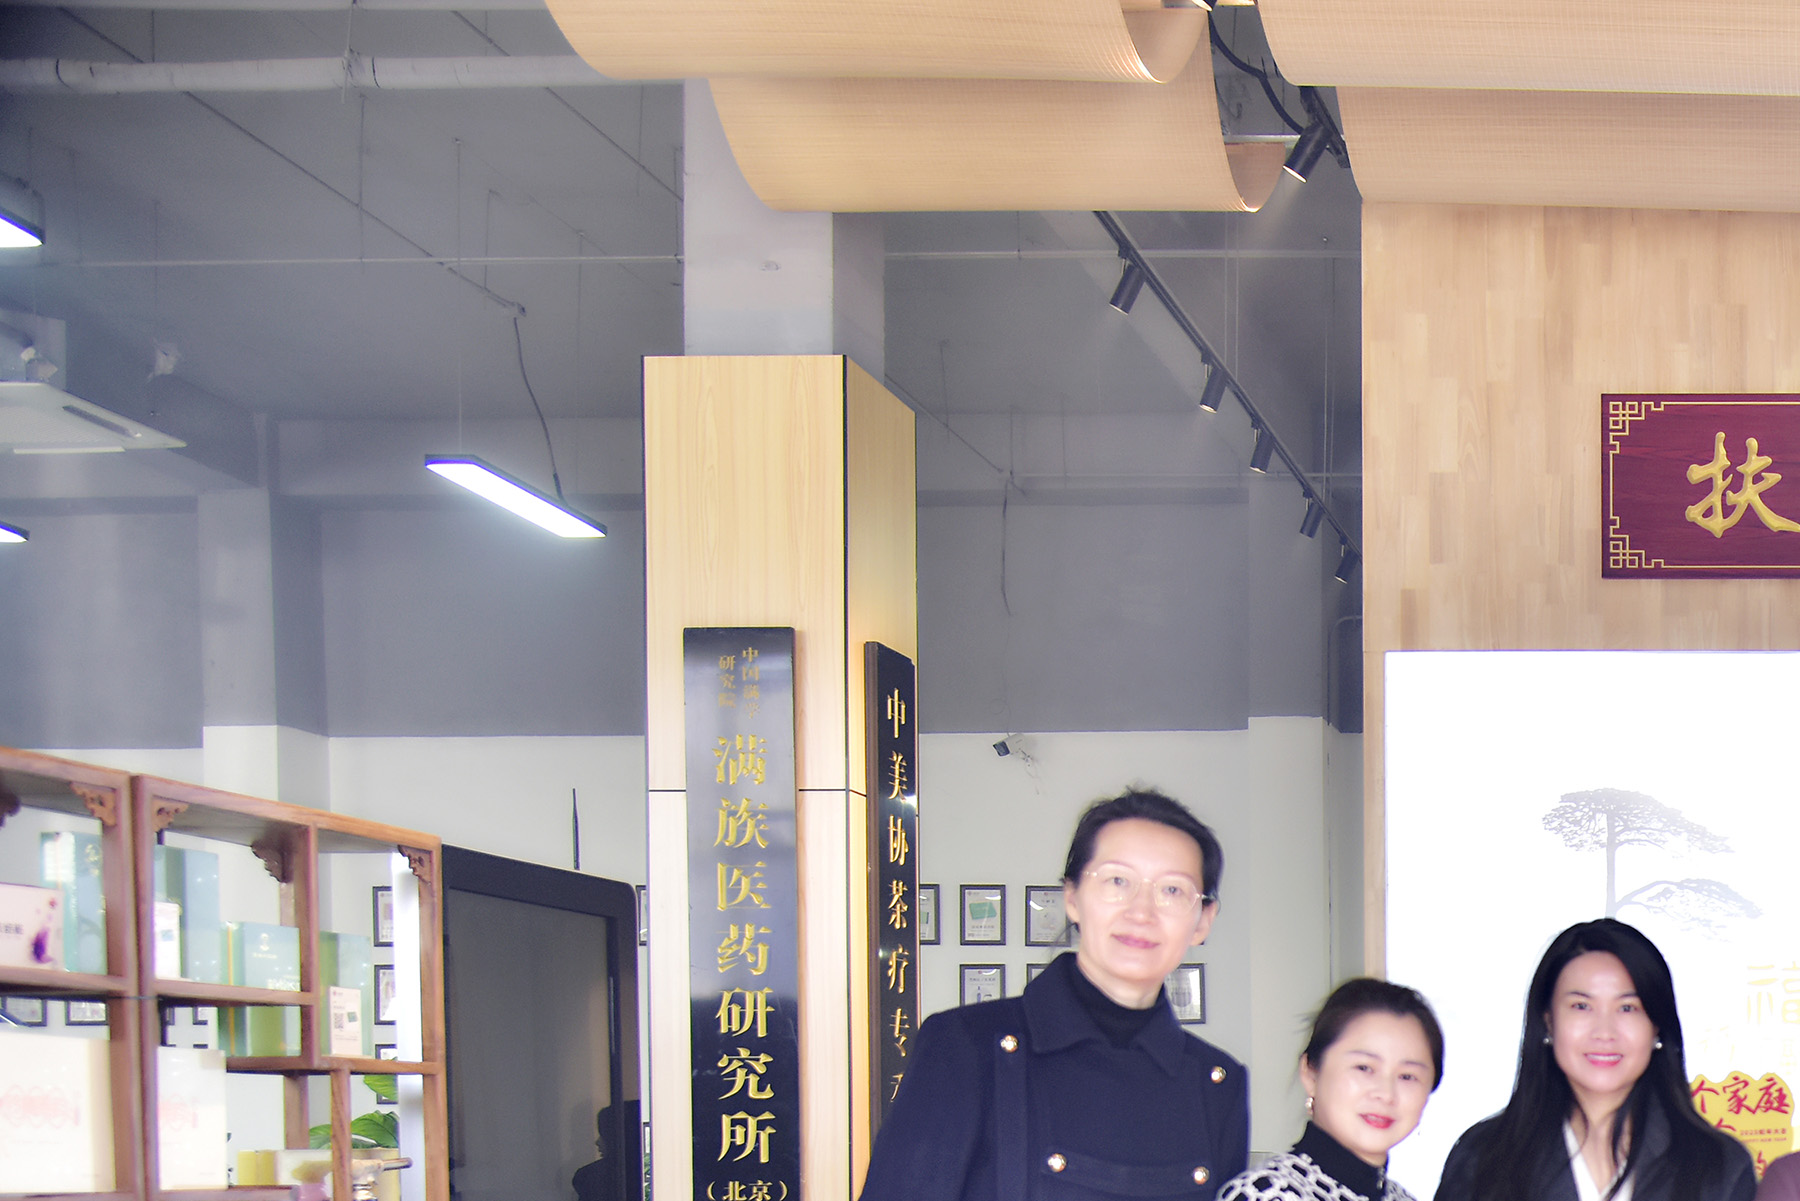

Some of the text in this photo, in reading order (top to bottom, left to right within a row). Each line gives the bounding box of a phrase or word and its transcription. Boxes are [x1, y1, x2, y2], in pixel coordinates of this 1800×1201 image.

[712, 735, 777, 1166] 满族医药研究所
[886, 687, 910, 1104] 中美协茶疗专
